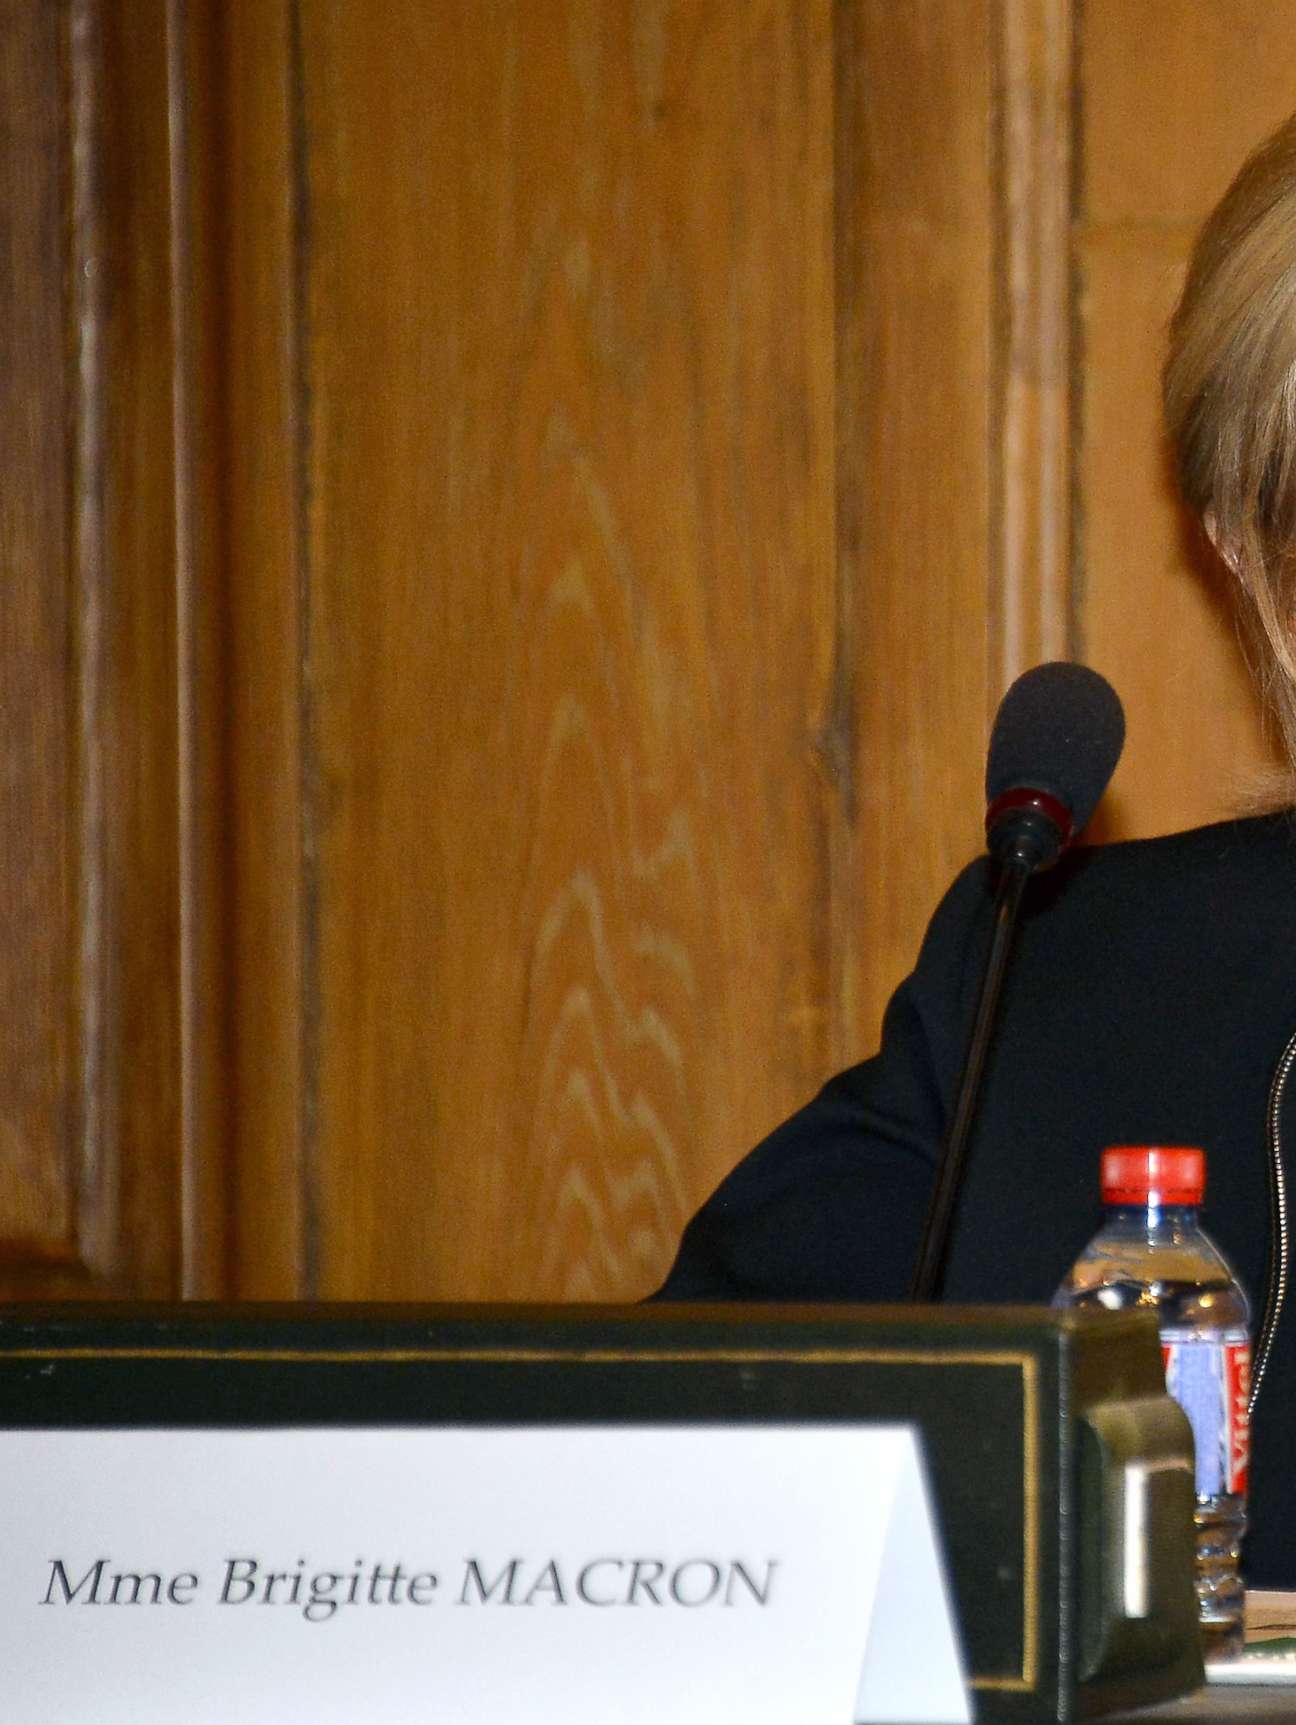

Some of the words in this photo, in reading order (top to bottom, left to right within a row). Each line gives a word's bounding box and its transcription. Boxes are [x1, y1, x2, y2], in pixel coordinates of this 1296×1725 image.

[38, 1558, 199, 1605] Mme
[219, 1558, 438, 1622] Brigitte
[455, 1558, 779, 1606] MACRON
